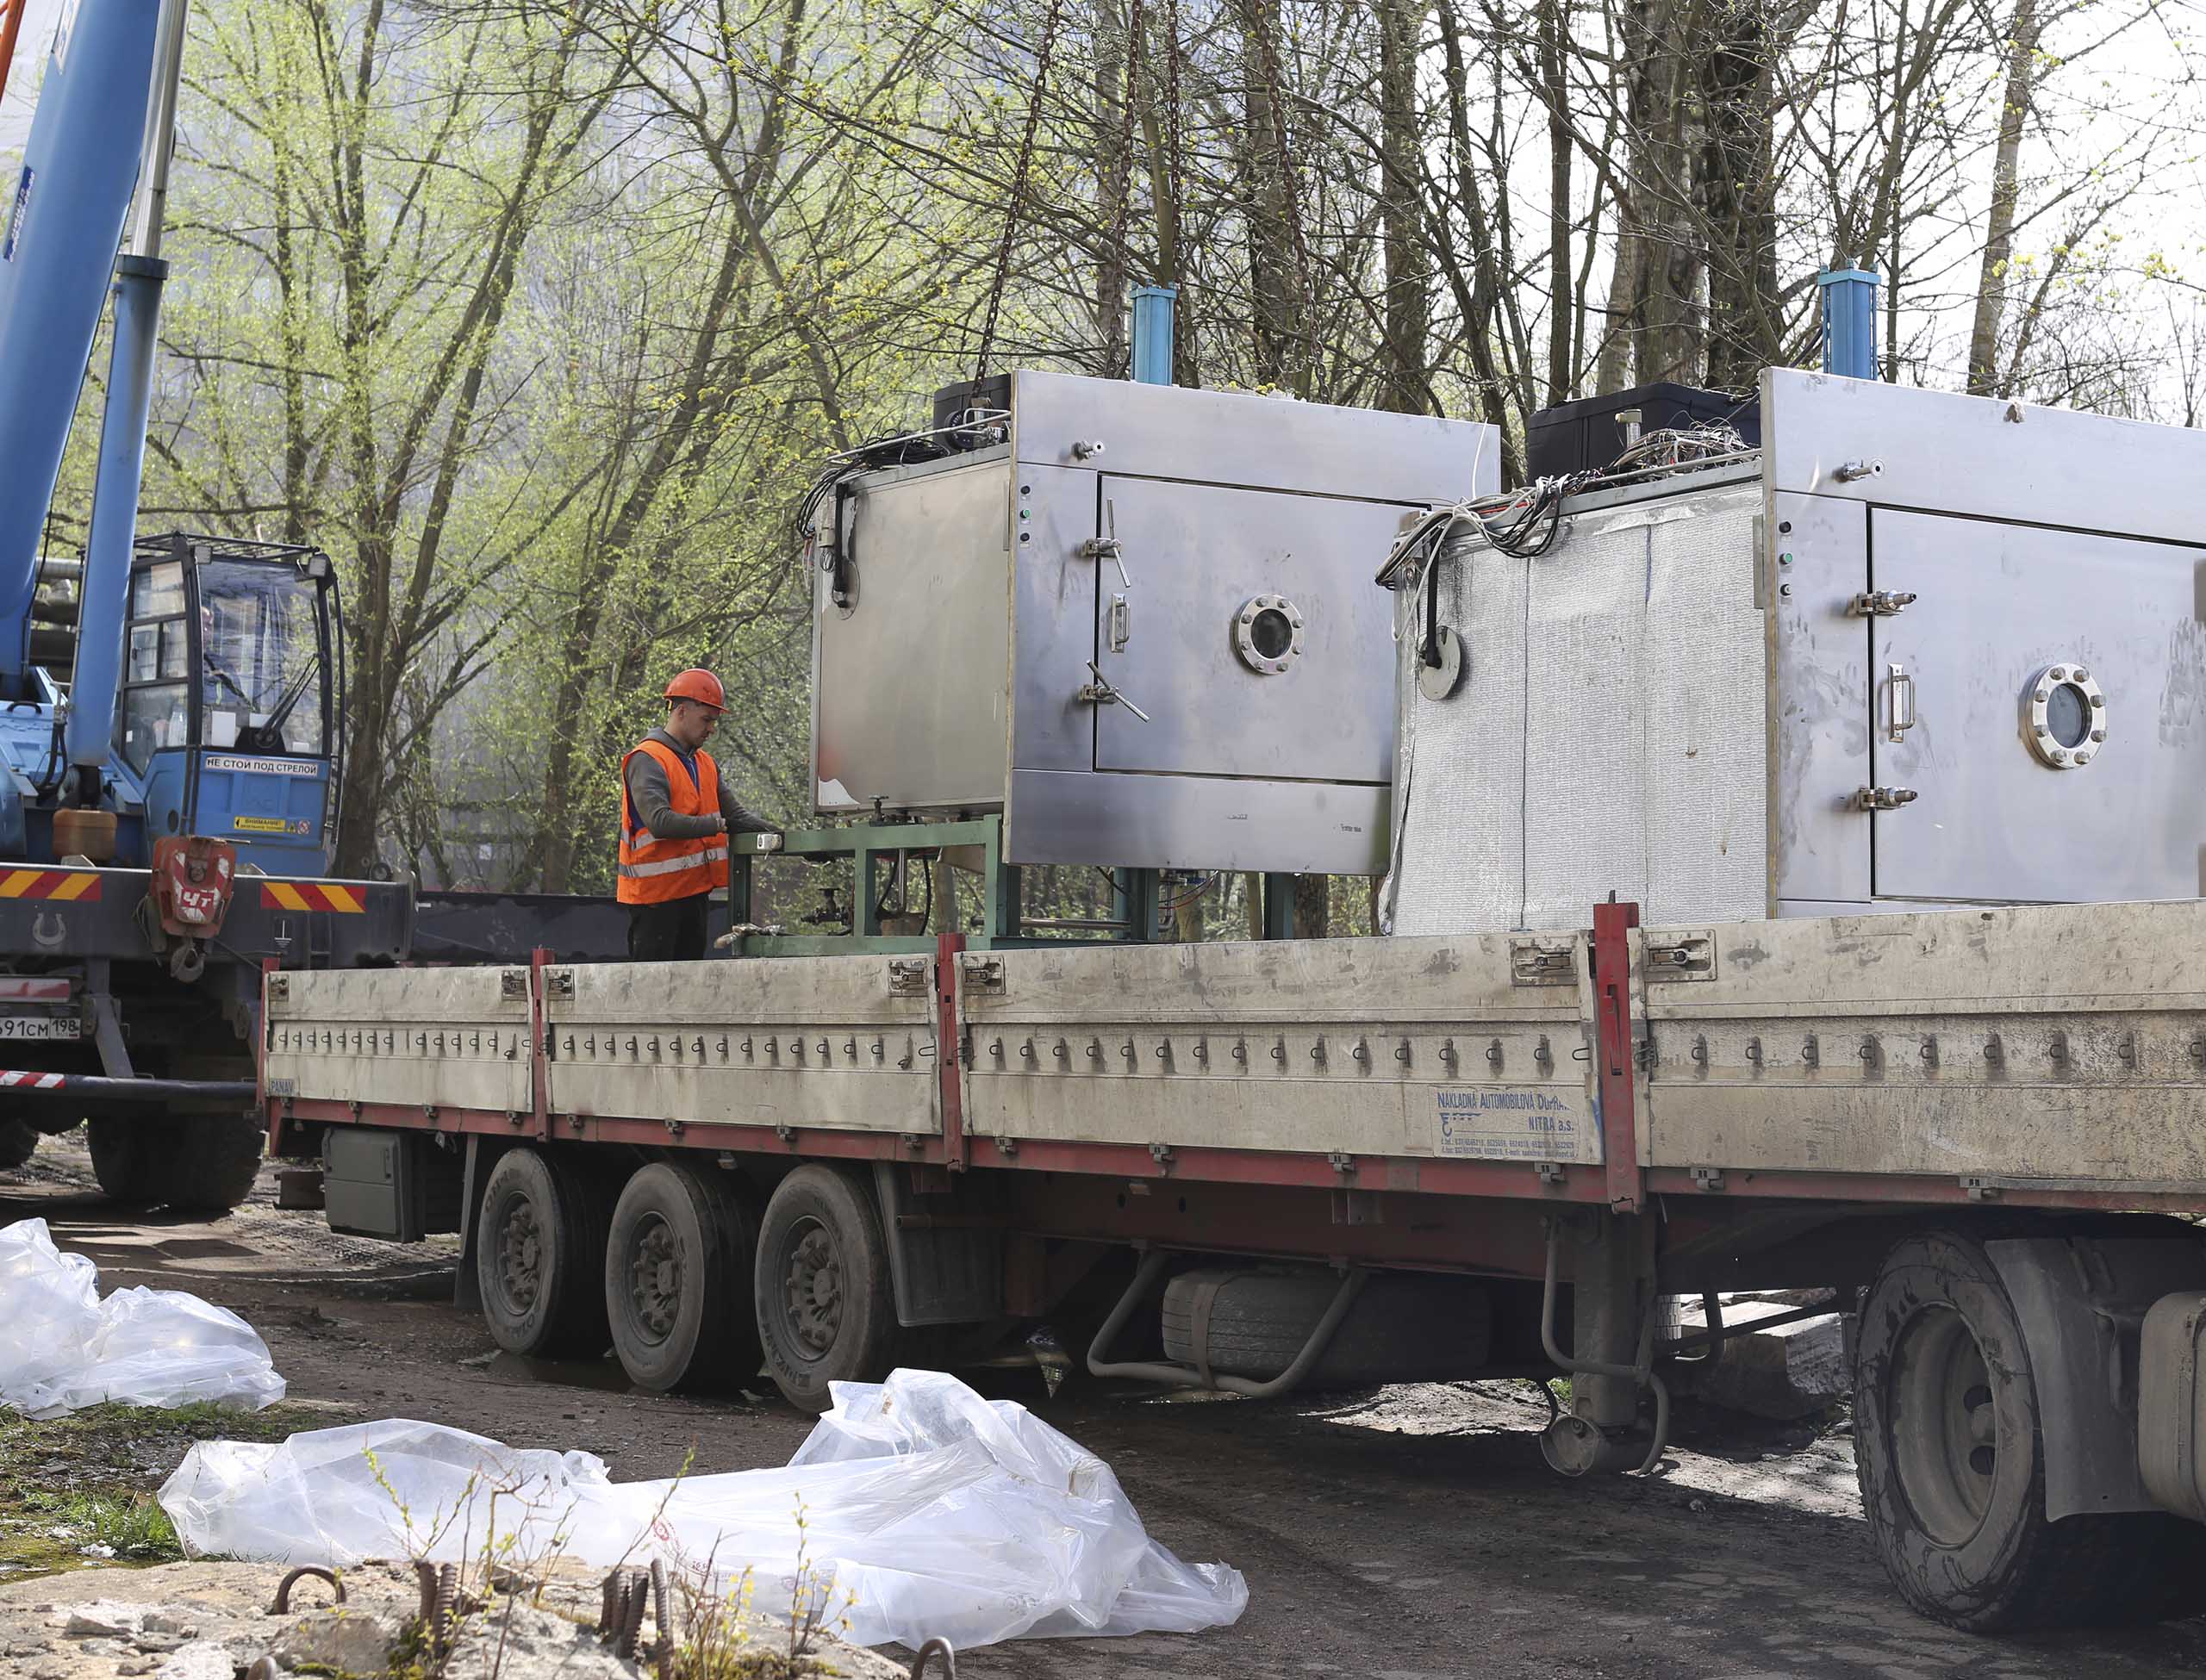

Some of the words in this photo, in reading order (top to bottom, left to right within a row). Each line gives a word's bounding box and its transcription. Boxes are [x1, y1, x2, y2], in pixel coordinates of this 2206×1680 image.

[207, 758, 221, 767] НЕ
[253, 762, 275, 773] ПОД
[276, 763, 317, 774] СТРЕЛОЙ
[53, 1020, 78, 1032] 198
[1528, 1116, 1555, 1131] NITRA
[1558, 1119, 1574, 1131] a.s.
